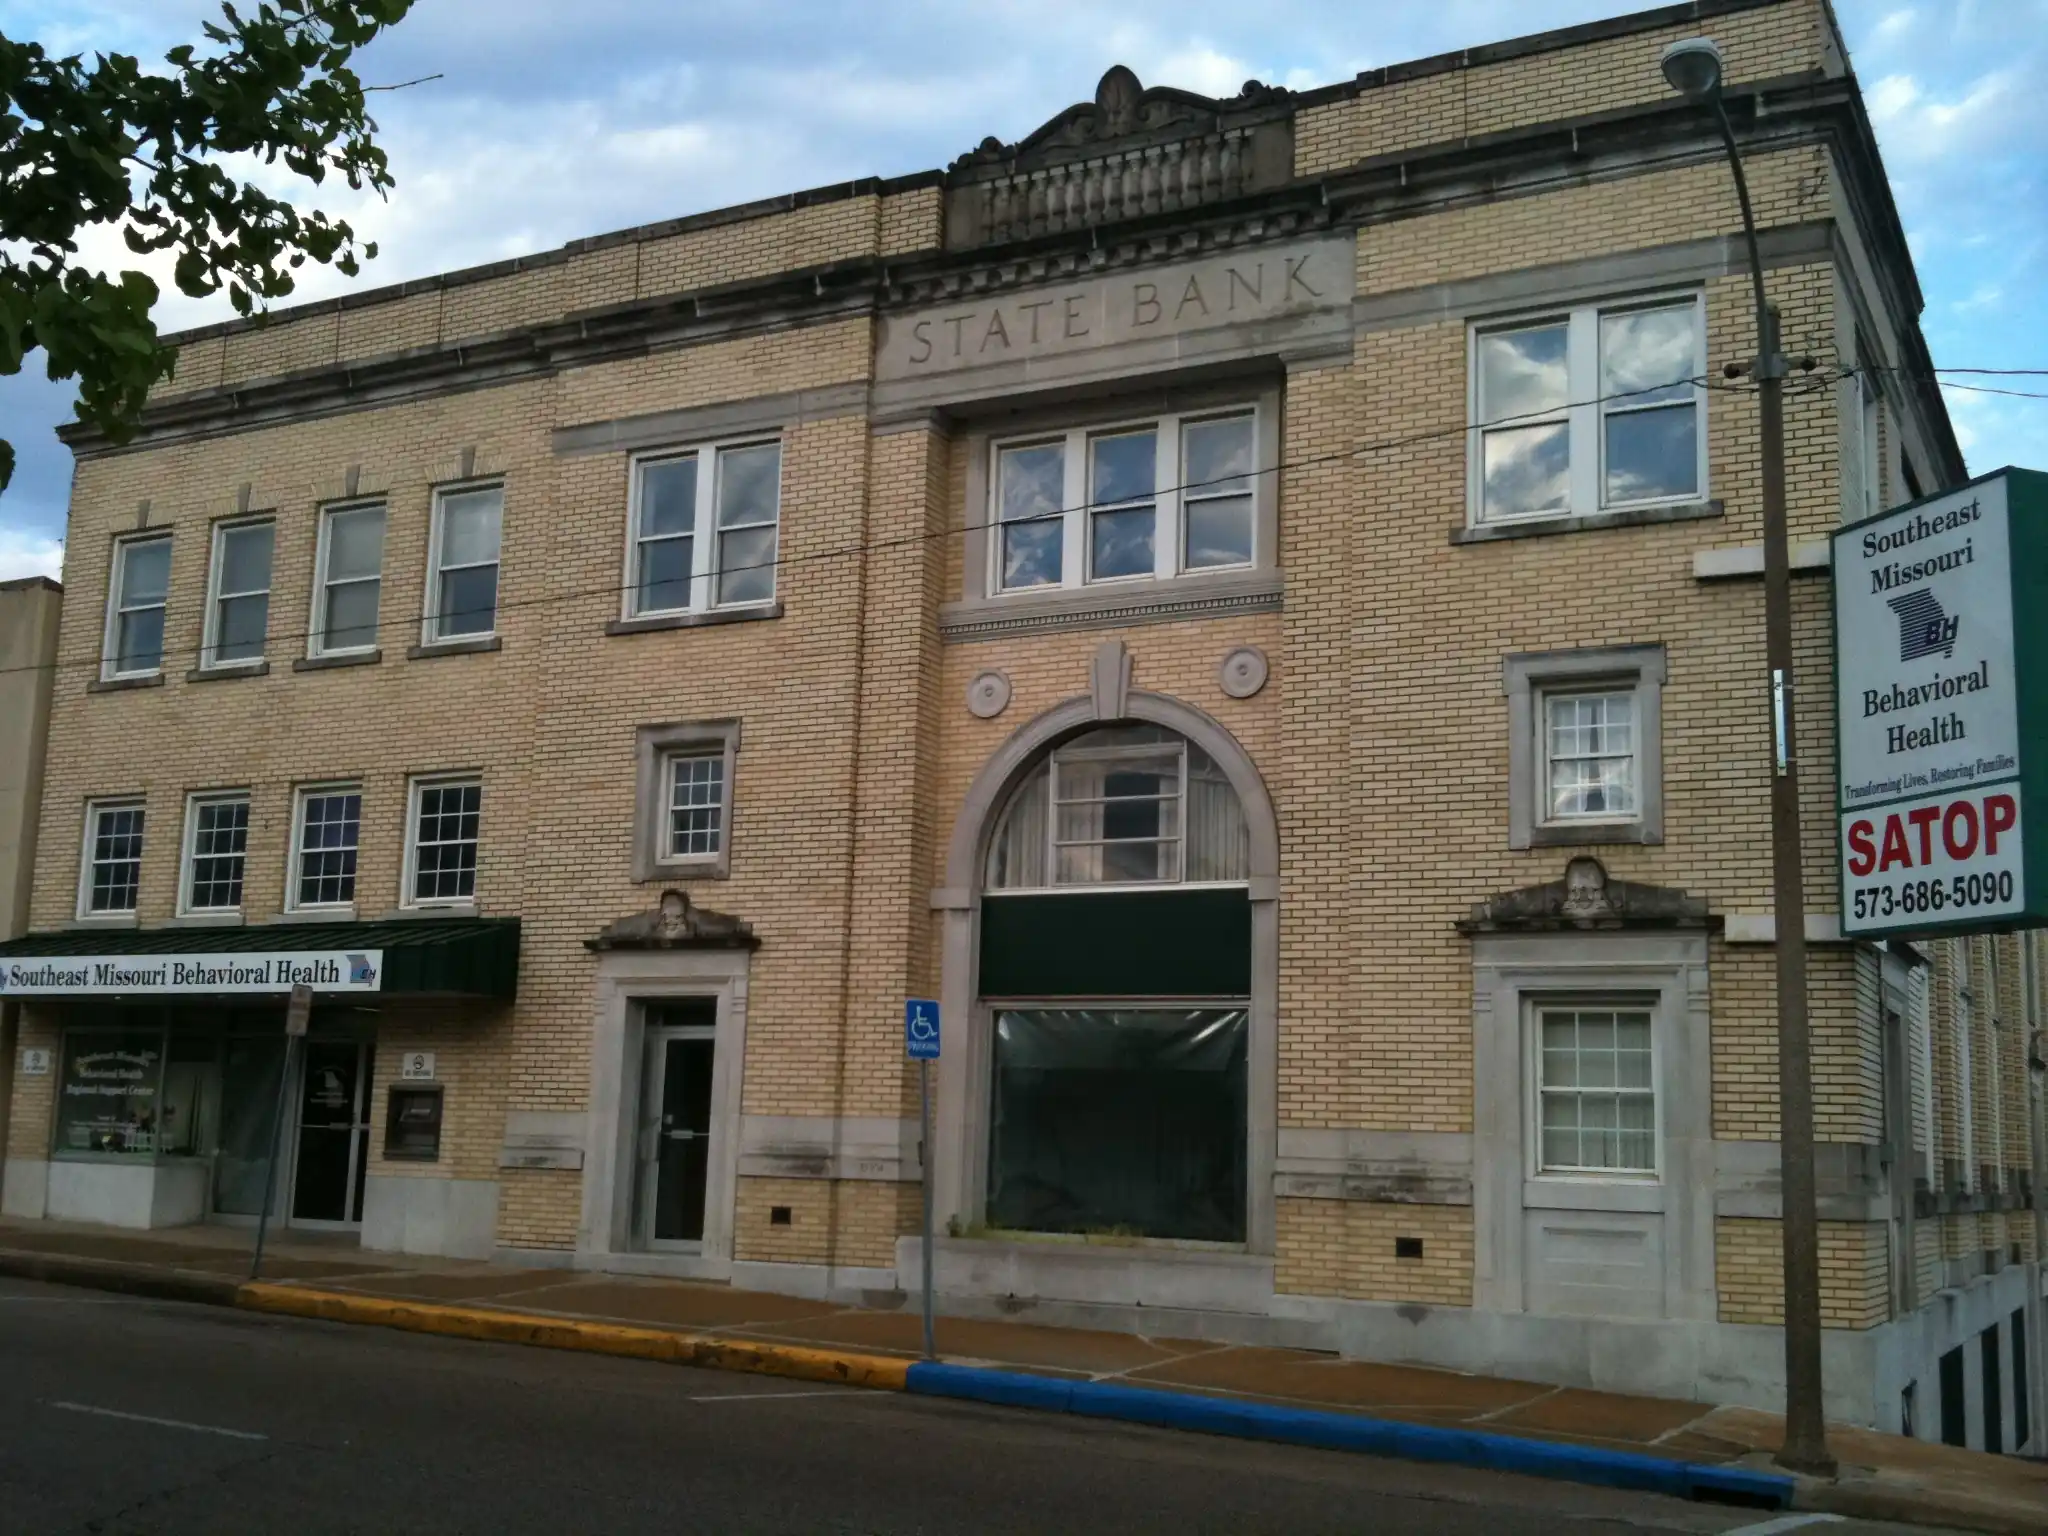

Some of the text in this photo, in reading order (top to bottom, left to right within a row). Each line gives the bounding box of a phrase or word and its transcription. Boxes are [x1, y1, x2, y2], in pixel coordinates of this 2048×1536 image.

[908, 254, 1324, 364] STATE BANK
[1862, 497, 1982, 559] Southeast
[1870, 538, 1975, 595] Missouri
[1924, 614, 1960, 647] BH
[1862, 660, 1990, 718] Behavioral
[1886, 712, 1966, 755] Health
[1844, 777, 1902, 800] Transforming
[1930, 763, 1974, 784] Restoring
[1976, 754, 2015, 775] Families
[1847, 793, 2017, 877] SATOP
[1853, 869, 2014, 920] 573-686-5090
[10, 963, 89, 987] Southeast
[92, 962, 167, 986] Missouri
[172, 960, 271, 985] Behavioral
[275, 959, 340, 984] Health
